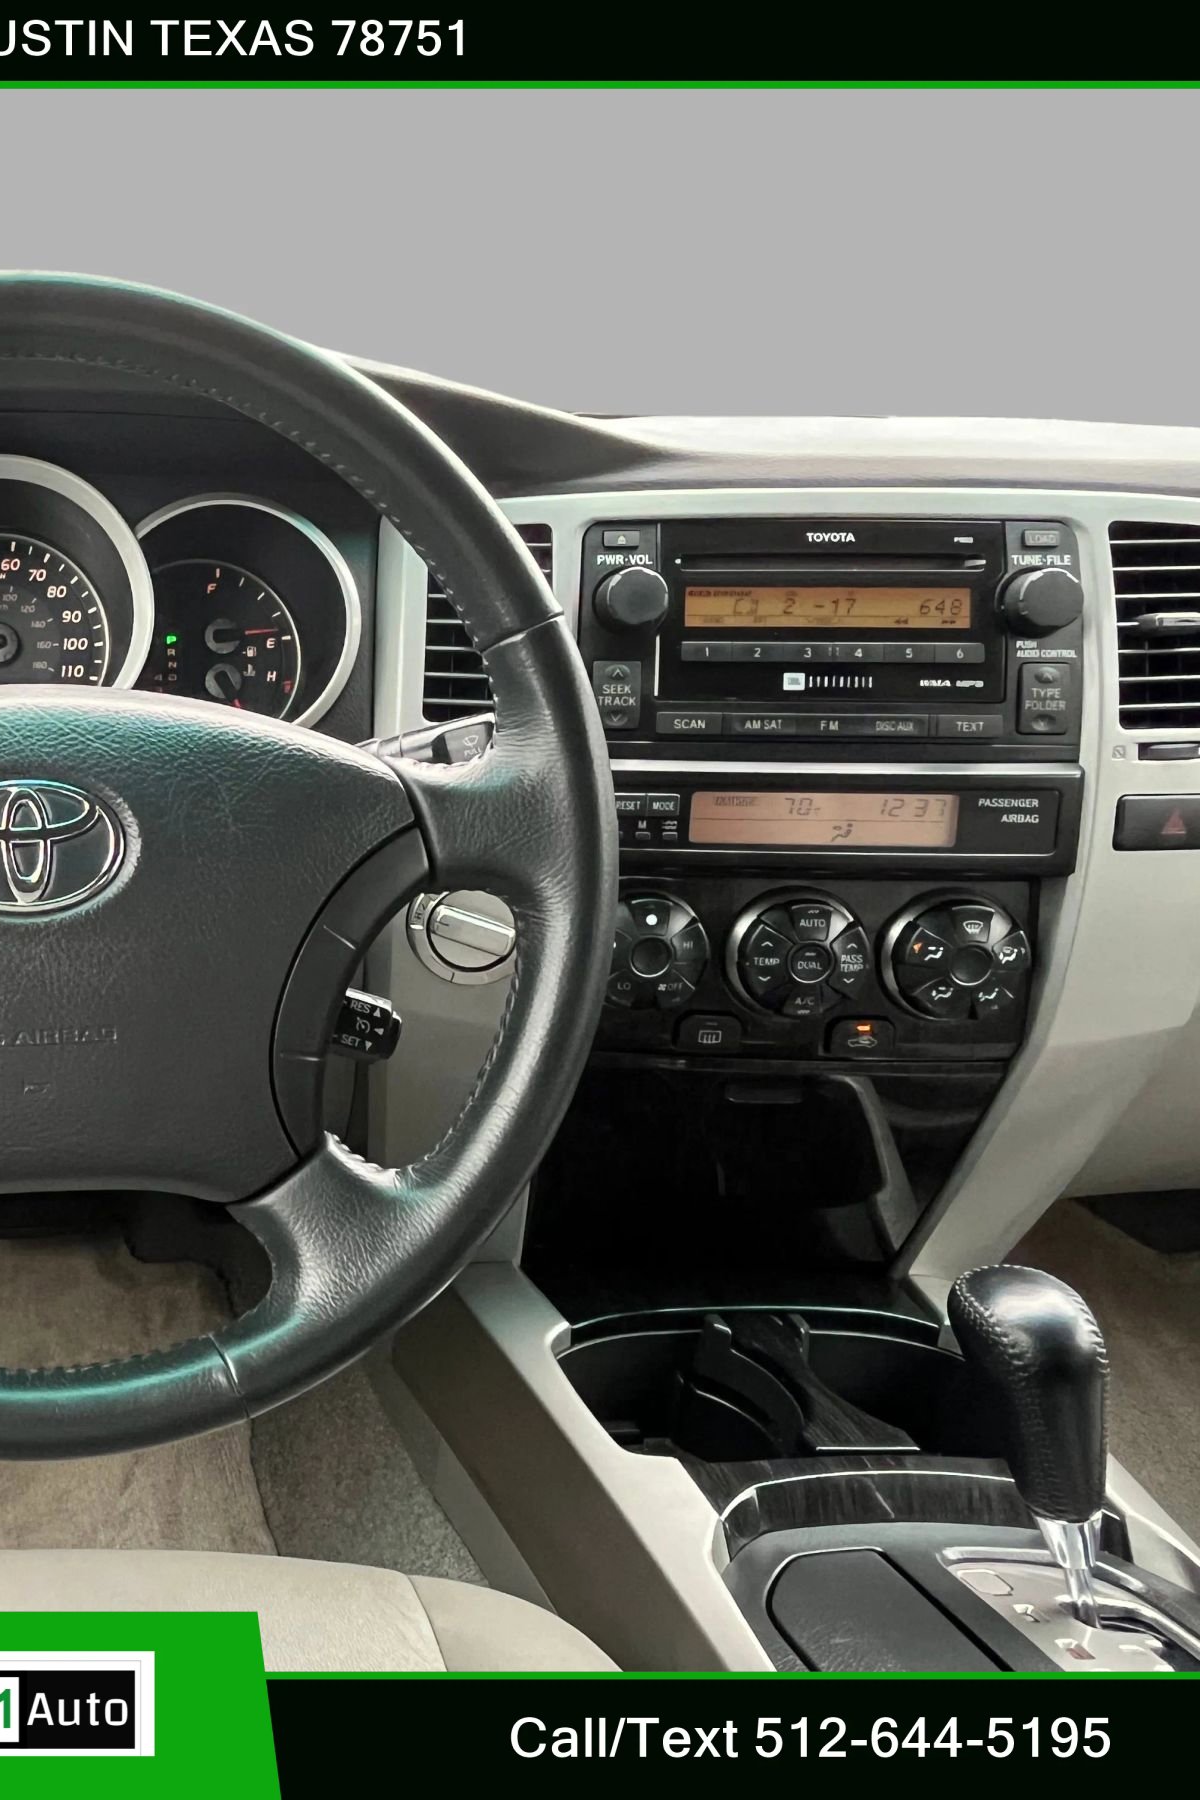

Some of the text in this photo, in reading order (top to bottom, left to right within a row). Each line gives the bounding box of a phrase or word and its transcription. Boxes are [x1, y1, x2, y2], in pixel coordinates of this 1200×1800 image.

[806, 532, 855, 543] TOYOTA
[1, 558, 20, 571] 60
[28, 569, 47, 581] 70
[46, 585, 66, 598] 80
[207, 583, 217, 594] F
[62, 610, 82, 623] 90
[63, 638, 88, 650] 100
[266, 638, 276, 649] E
[754, 648, 761, 657] 2
[803, 648, 812, 657] 3
[854, 648, 863, 658] 4
[905, 648, 913, 658] 5
[956, 648, 964, 658] 6
[61, 665, 84, 678] 110
[267, 671, 277, 682] H
[602, 684, 632, 694] SEEK
[1031, 688, 1061, 699] TYPE
[598, 696, 636, 706] TRACK
[1025, 700, 1066, 711] FOLDER
[673, 719, 706, 730] SCAN
[956, 721, 984, 732] TEXT
[978, 798, 1039, 808] PASSENGER
[1001, 814, 1039, 824] AIRBAG
[799, 918, 826, 928] AUTO
[683, 941, 694, 949] HI
[753, 957, 780, 966] TEMP
[840, 954, 863, 963] PASS
[797, 961, 822, 970] DUAL
